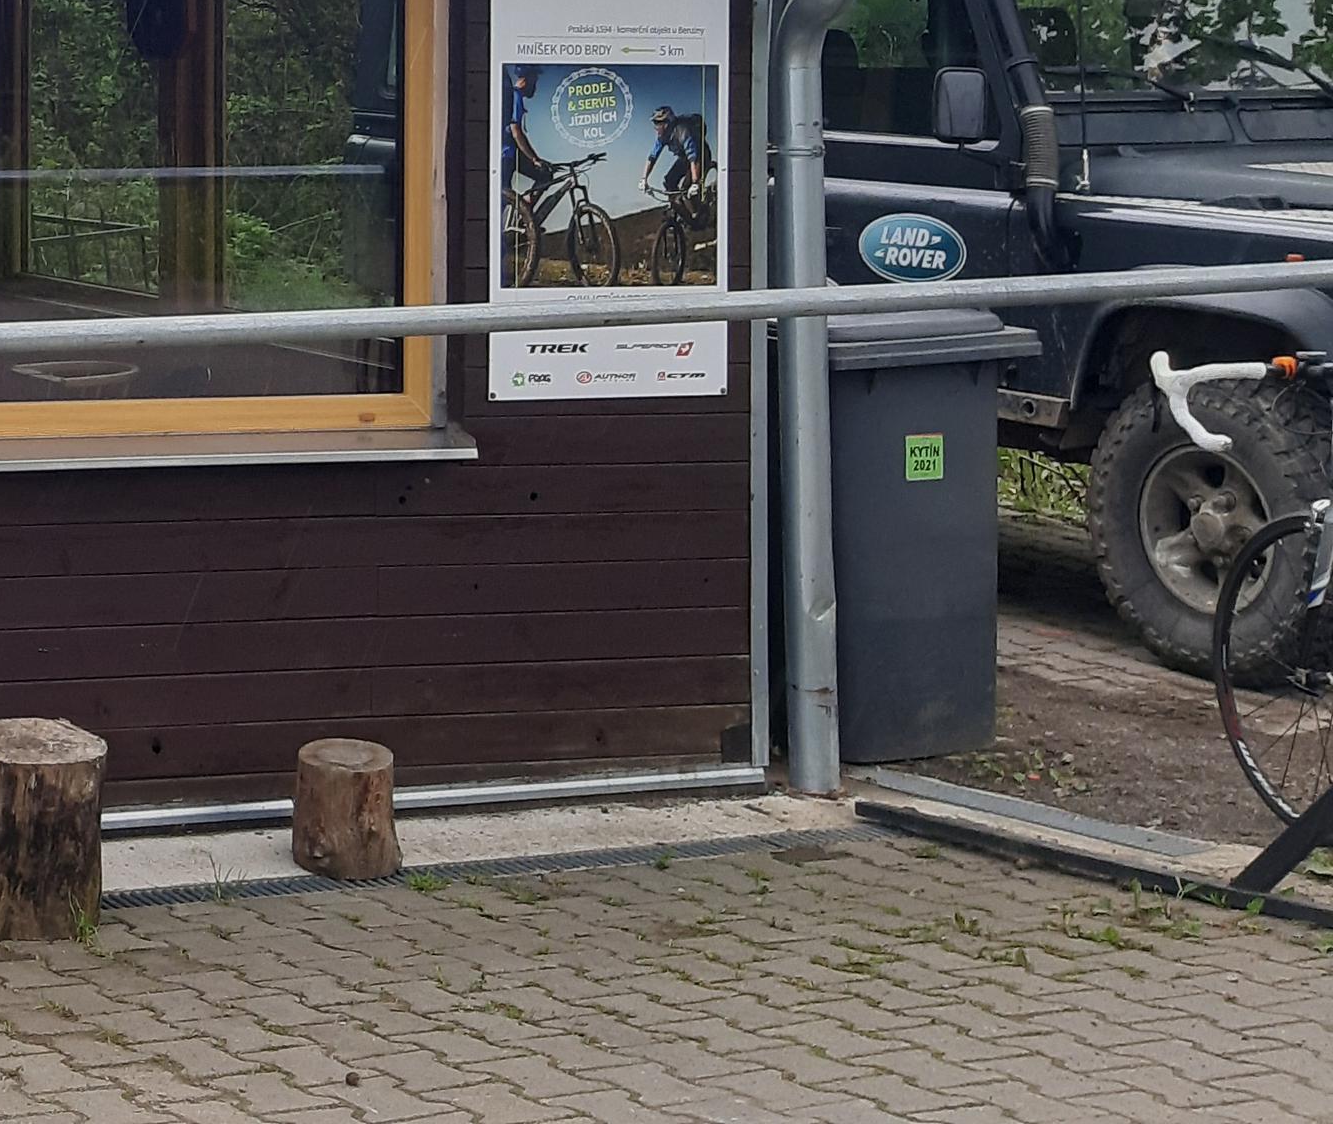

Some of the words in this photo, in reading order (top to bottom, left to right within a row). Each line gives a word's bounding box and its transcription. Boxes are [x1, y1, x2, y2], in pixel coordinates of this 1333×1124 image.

[517, 41, 557, 56] MNÍŠEK
[559, 44, 582, 56] POD
[584, 44, 612, 56] BRDY
[659, 44, 667, 57] 5
[668, 44, 684, 57] km
[568, 82, 613, 97] PRODEJ
[568, 101, 575, 112] &
[578, 96, 616, 110] SERVIS
[568, 110, 617, 126] JÍZDNÍCH
[583, 127, 606, 139] KOL
[880, 226, 931, 247] LAND
[884, 247, 947, 270] ROVER
[526, 343, 589, 354] TREK
[910, 443, 940, 458] KYTÍN
[913, 459, 936, 472] 2021
